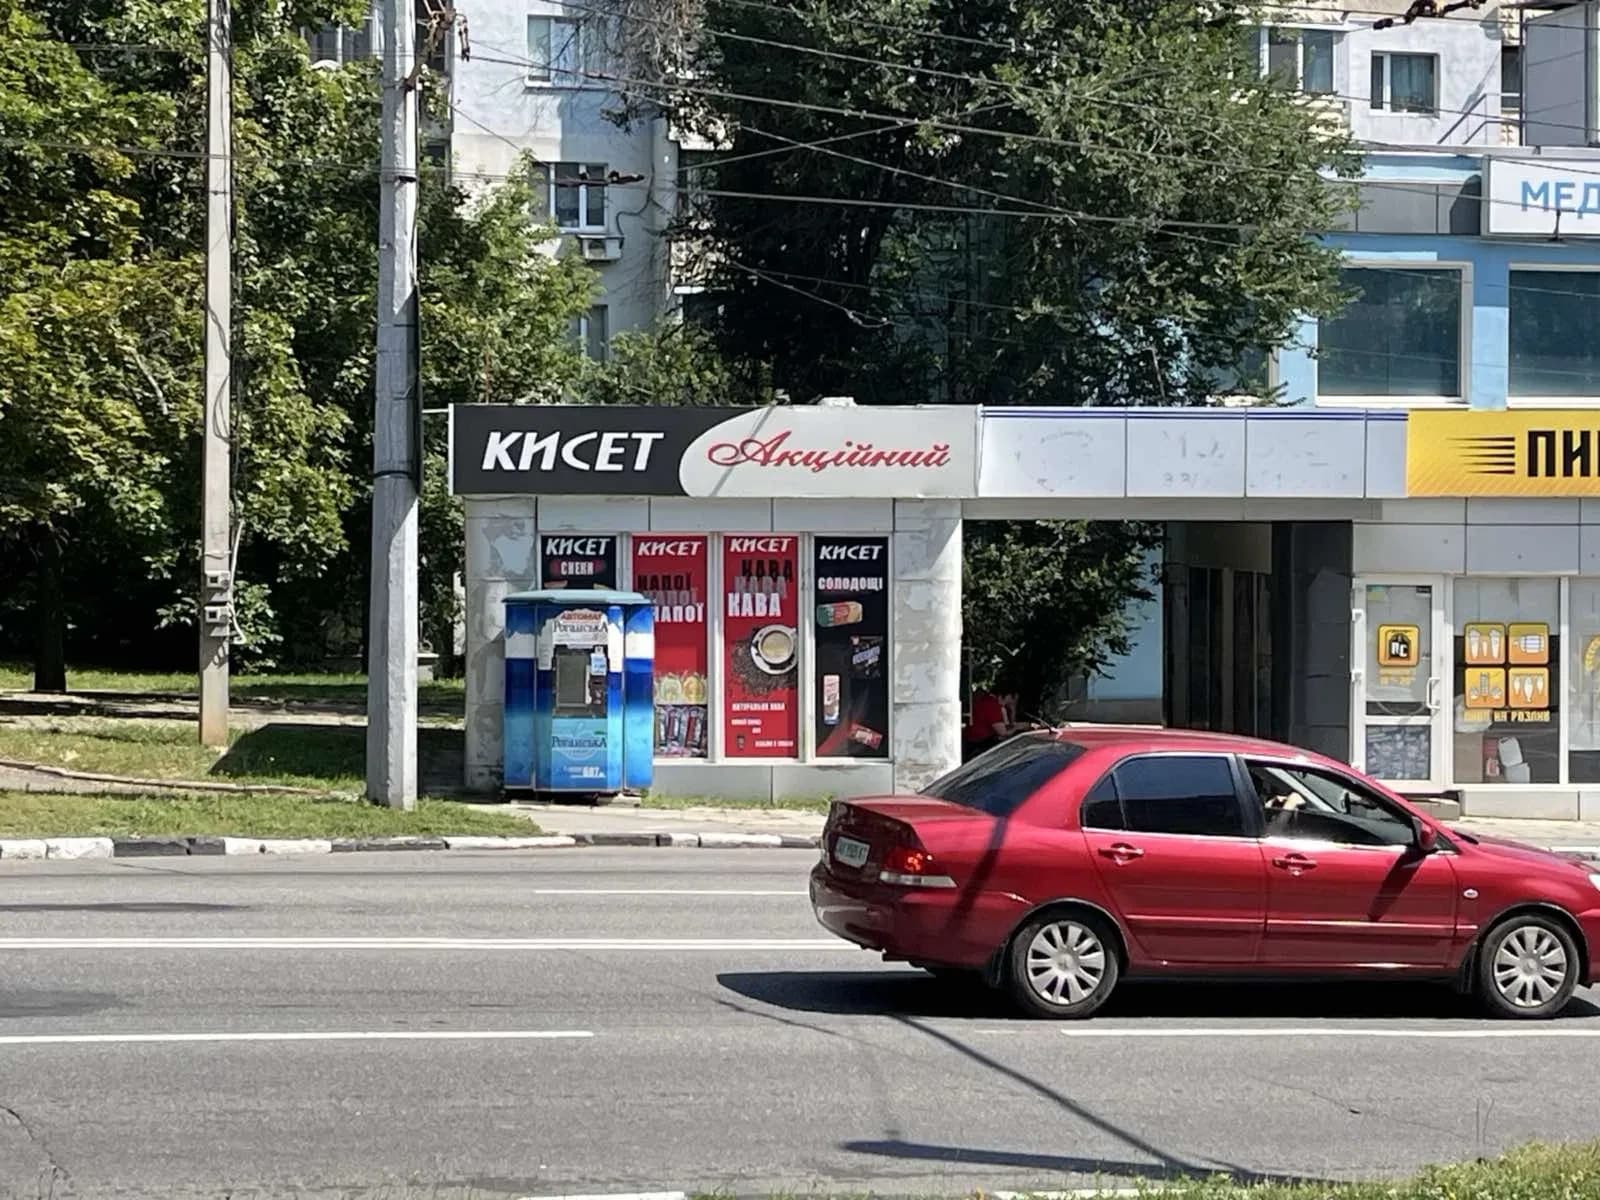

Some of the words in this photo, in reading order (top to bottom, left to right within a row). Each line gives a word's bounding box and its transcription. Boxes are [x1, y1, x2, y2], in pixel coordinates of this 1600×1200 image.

[481, 431, 664, 472] КИСЕТ
[708, 430, 951, 476] Акційний
[1528, 430, 1600, 477] ПИ
[545, 538, 611, 556] КИСЕТ
[637, 541, 702, 556] КИСЕТ
[730, 538, 793, 553] КИСЕТ
[819, 545, 883, 560] КИСЕТ
[560, 561, 595, 576] СНЕКИ
[818, 577, 883, 591] СОЛОДОЩІ
[727, 592, 782, 617] КАВА
